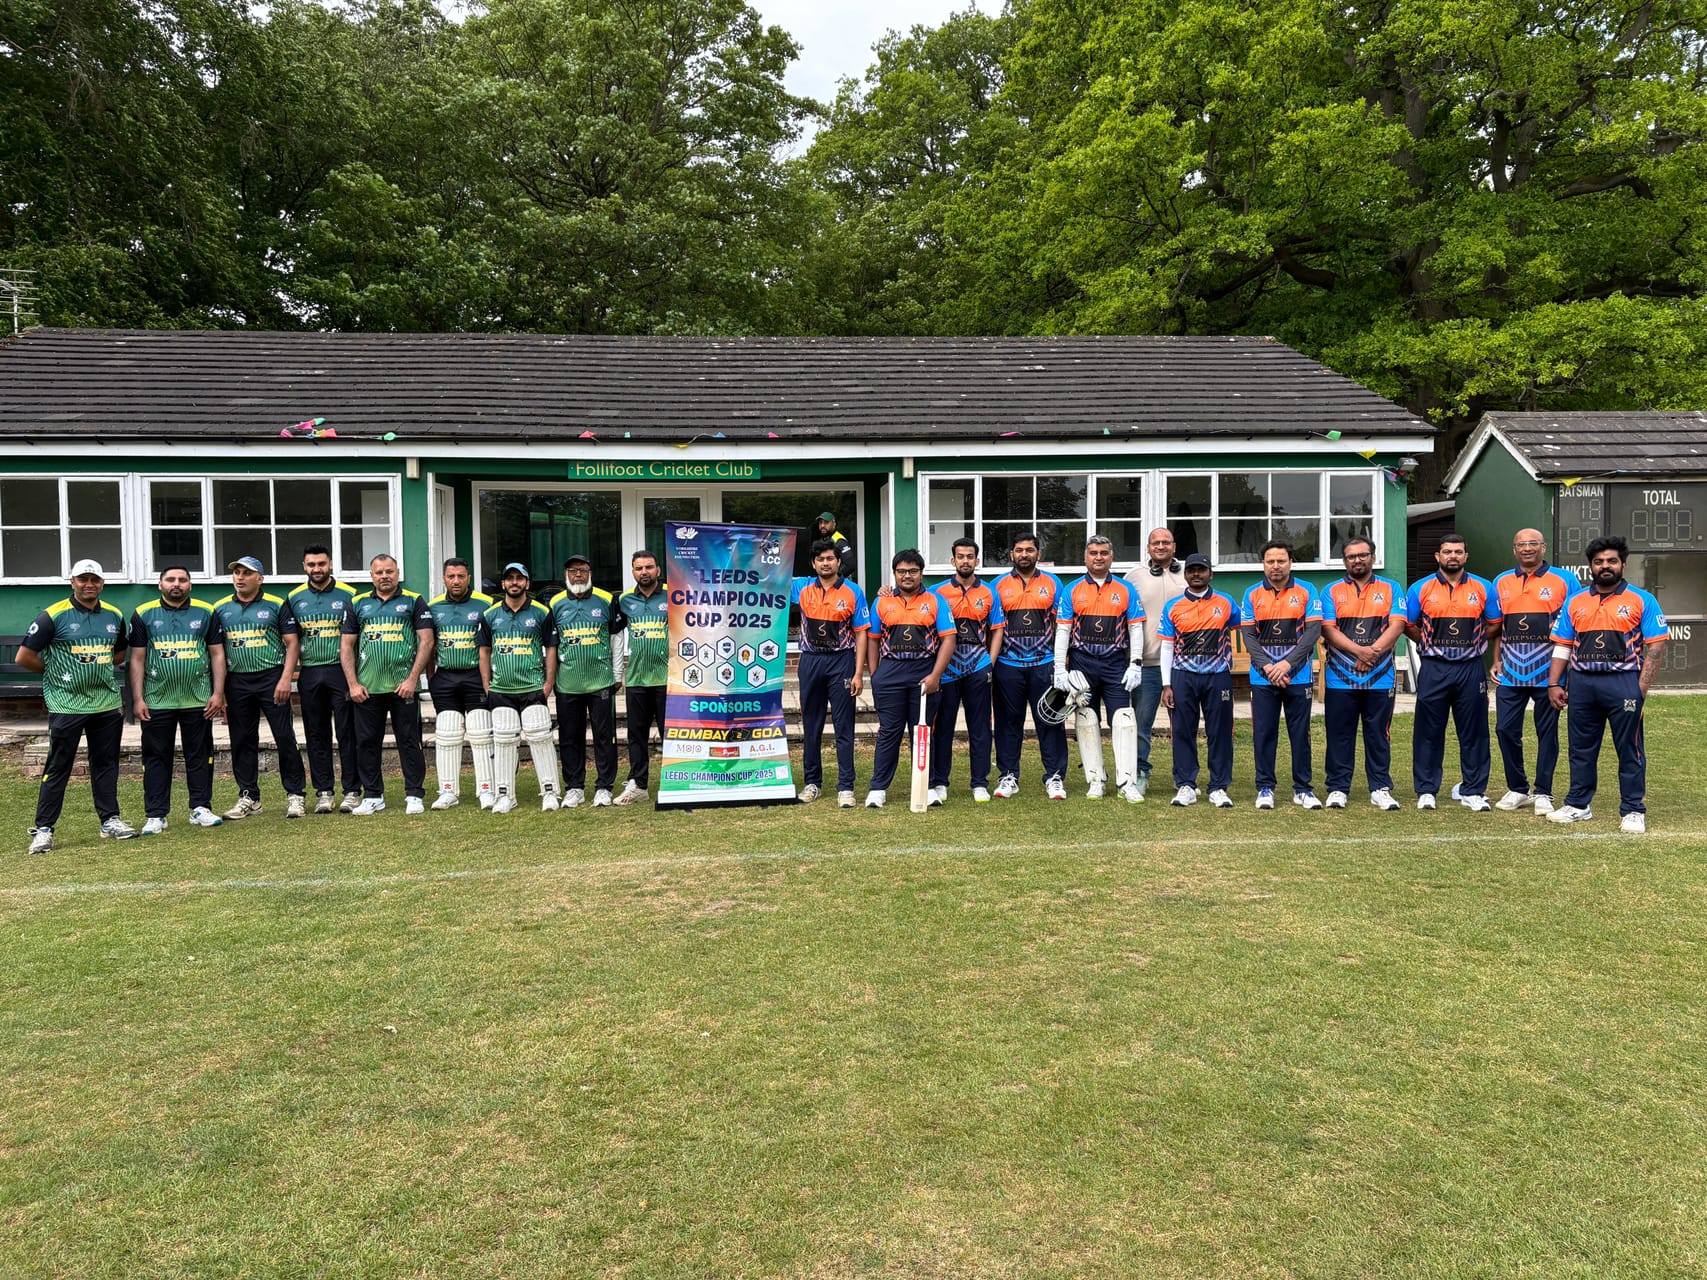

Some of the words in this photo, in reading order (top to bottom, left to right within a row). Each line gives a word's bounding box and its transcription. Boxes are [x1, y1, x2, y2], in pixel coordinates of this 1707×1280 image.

[576, 461, 644, 476] Follifoot
[650, 461, 710, 476] Cricket
[716, 461, 753, 476] Club
[1559, 484, 1604, 497] BATSMAN
[1643, 490, 1681, 505] TOTAL
[761, 556, 780, 564] LCC
[700, 569, 760, 585] LEEDS
[671, 590, 787, 609] CHAMPIONS
[686, 612, 722, 627] CUP
[728, 613, 772, 628] 2025
[689, 700, 762, 713] SPONSORS
[666, 728, 729, 740] BOMBAY
[752, 727, 784, 739] GOA
[665, 771, 688, 780] LEEDS
[691, 771, 736, 782] CHAMPIONS
[738, 771, 752, 780] CUP
[755, 769, 774, 778] 2025
